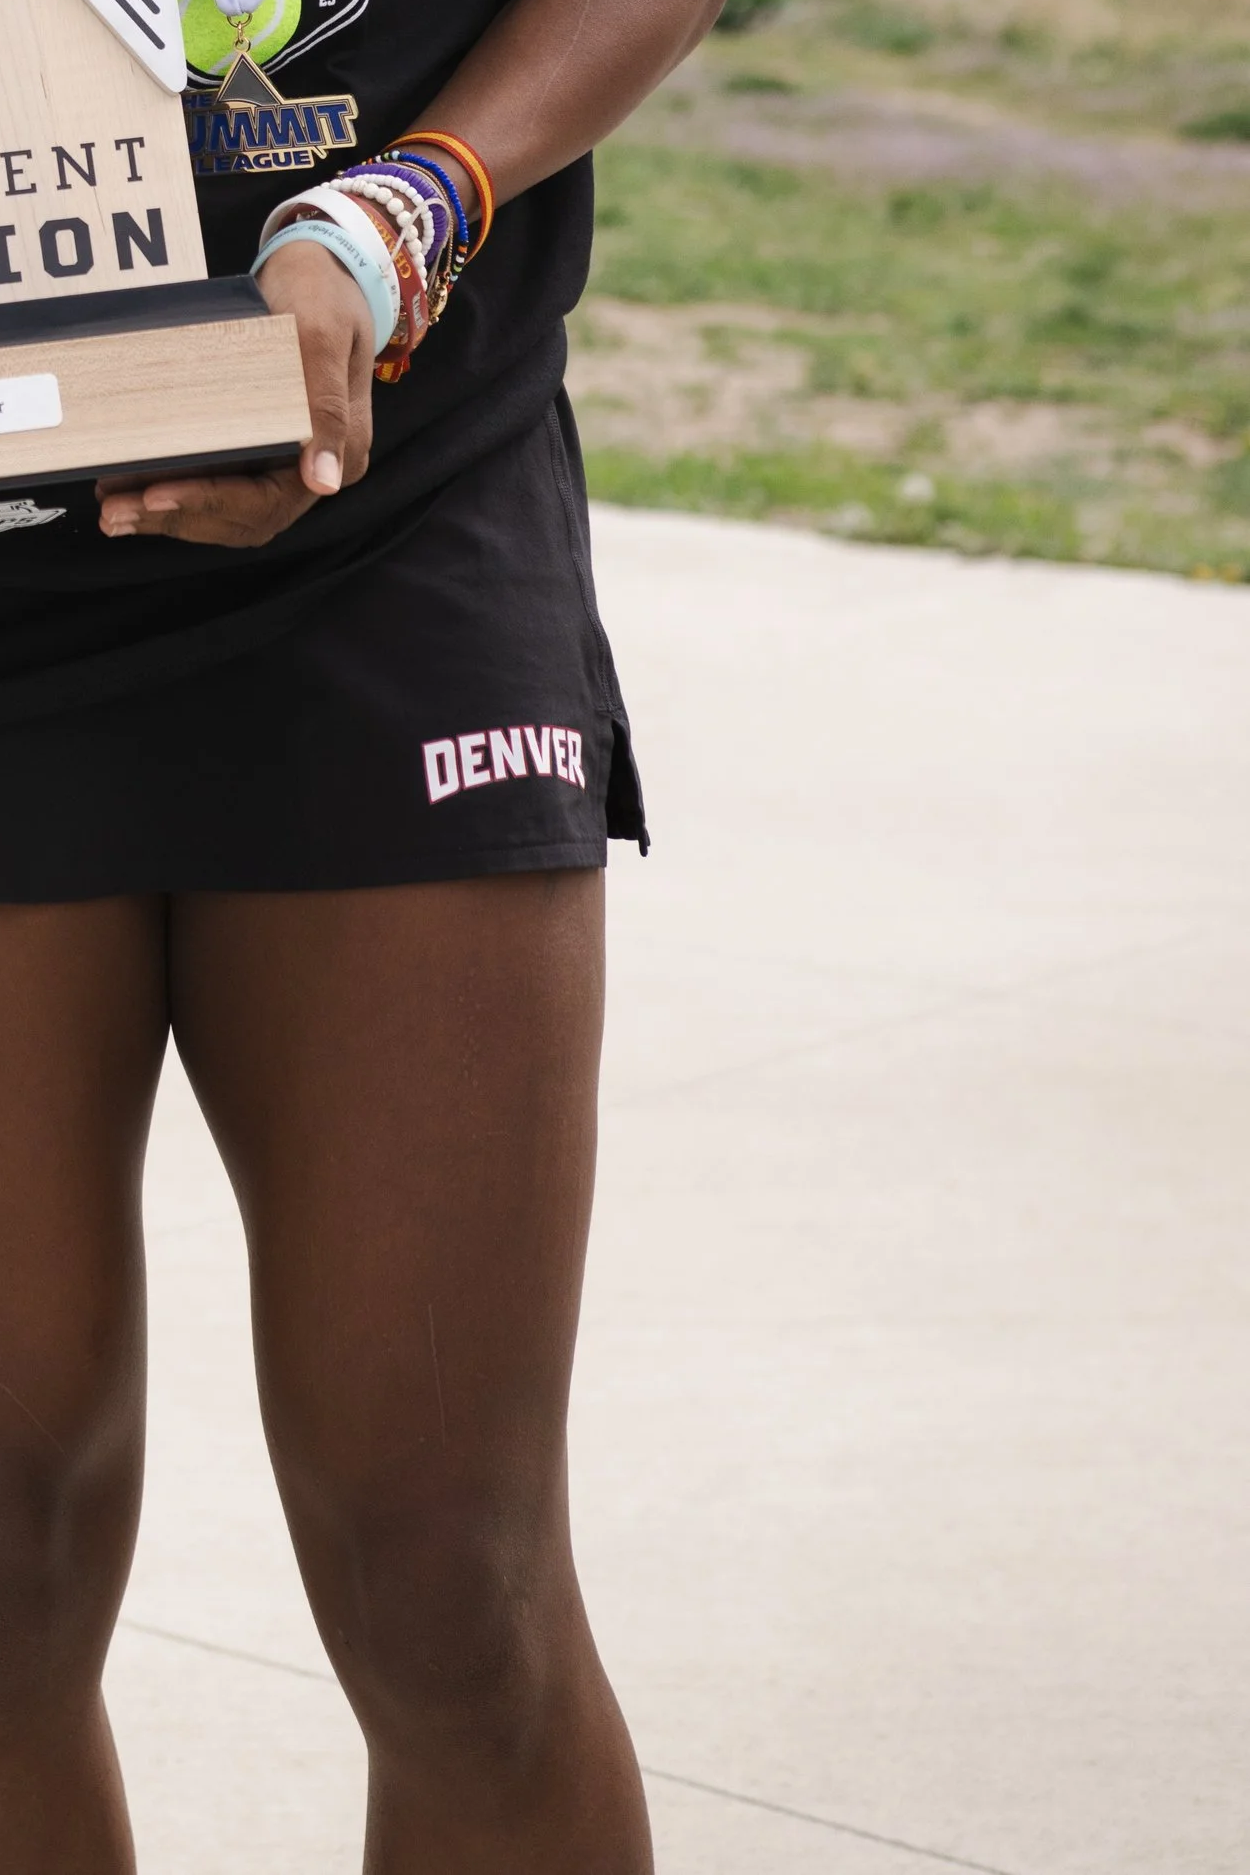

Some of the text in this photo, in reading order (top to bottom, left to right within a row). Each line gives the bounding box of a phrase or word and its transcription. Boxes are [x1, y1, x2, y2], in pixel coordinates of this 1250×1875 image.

[183, 92, 214, 108] HE
[187, 99, 354, 155] UMMIT
[196, 149, 312, 174] LEAGUE
[421, 724, 586, 805] DENVER
